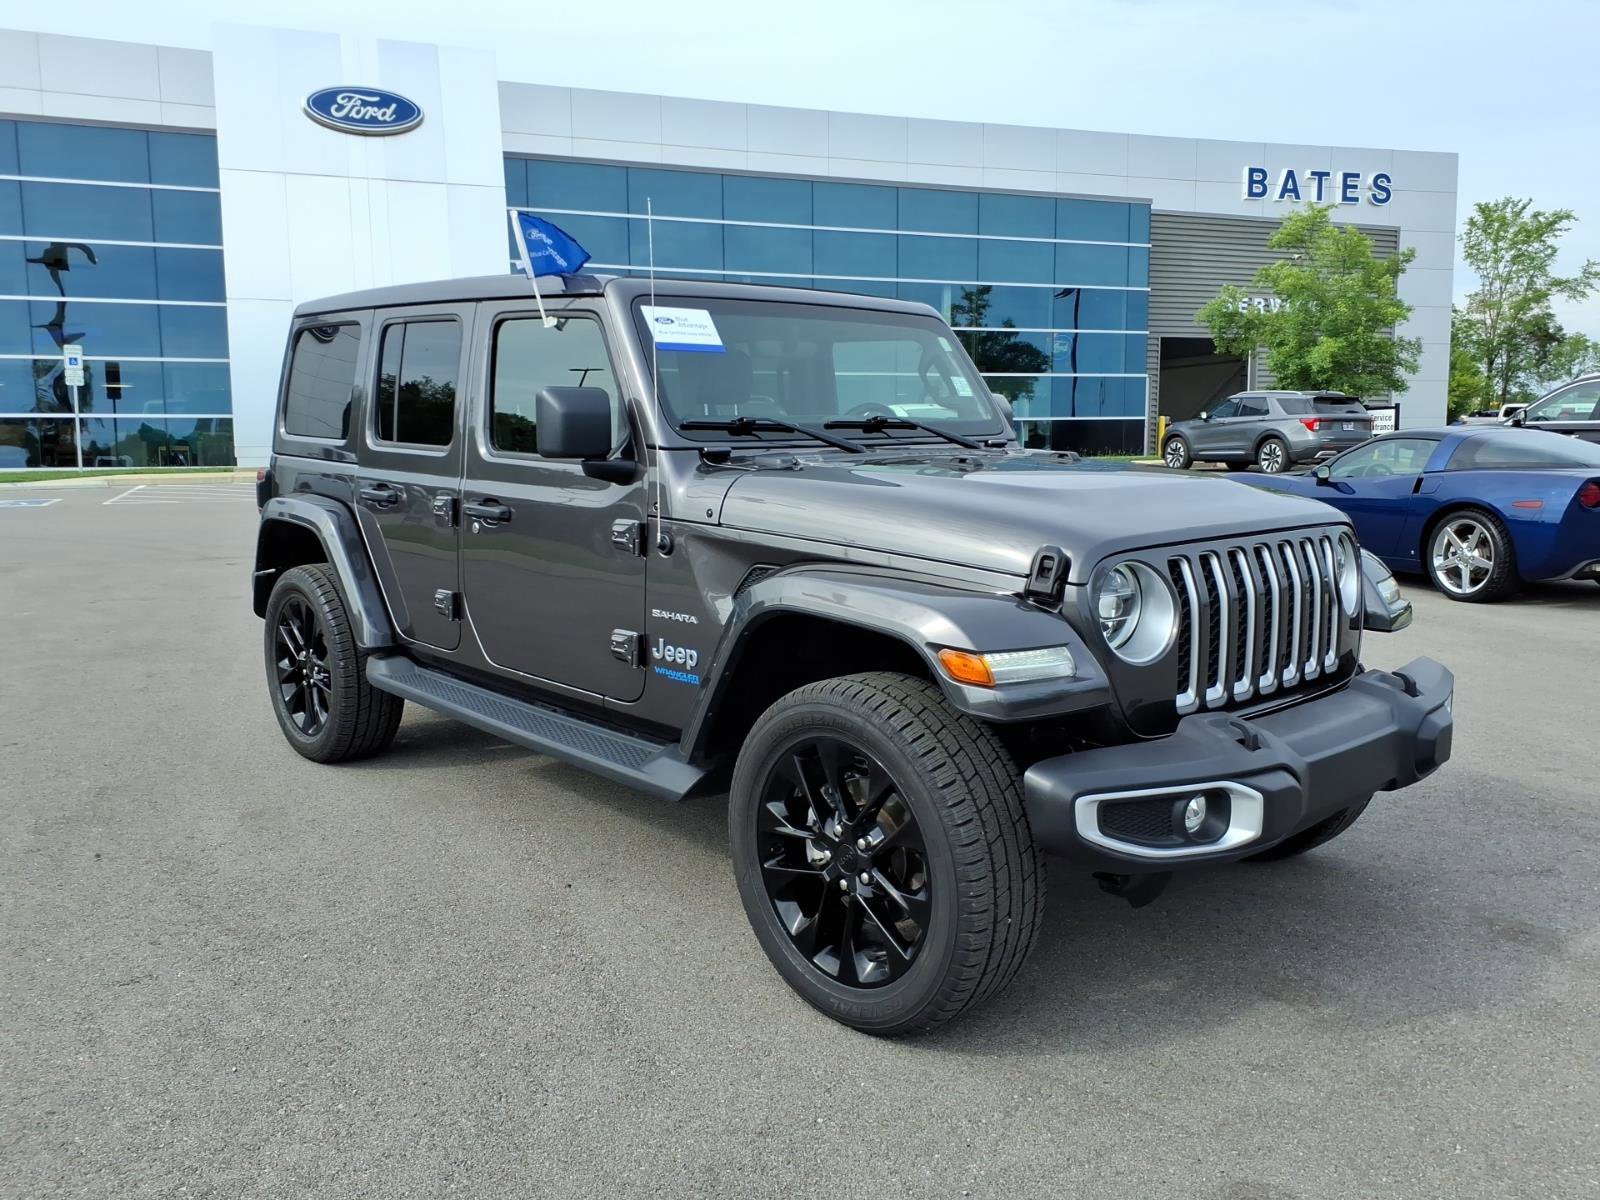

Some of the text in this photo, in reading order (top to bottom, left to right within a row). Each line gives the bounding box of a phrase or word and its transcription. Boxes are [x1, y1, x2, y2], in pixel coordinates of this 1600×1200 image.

[331, 93, 397, 122] Ford
[1244, 167, 1392, 205] BATES
[652, 609, 699, 624] SAHARA
[652, 638, 698, 670] Jeep
